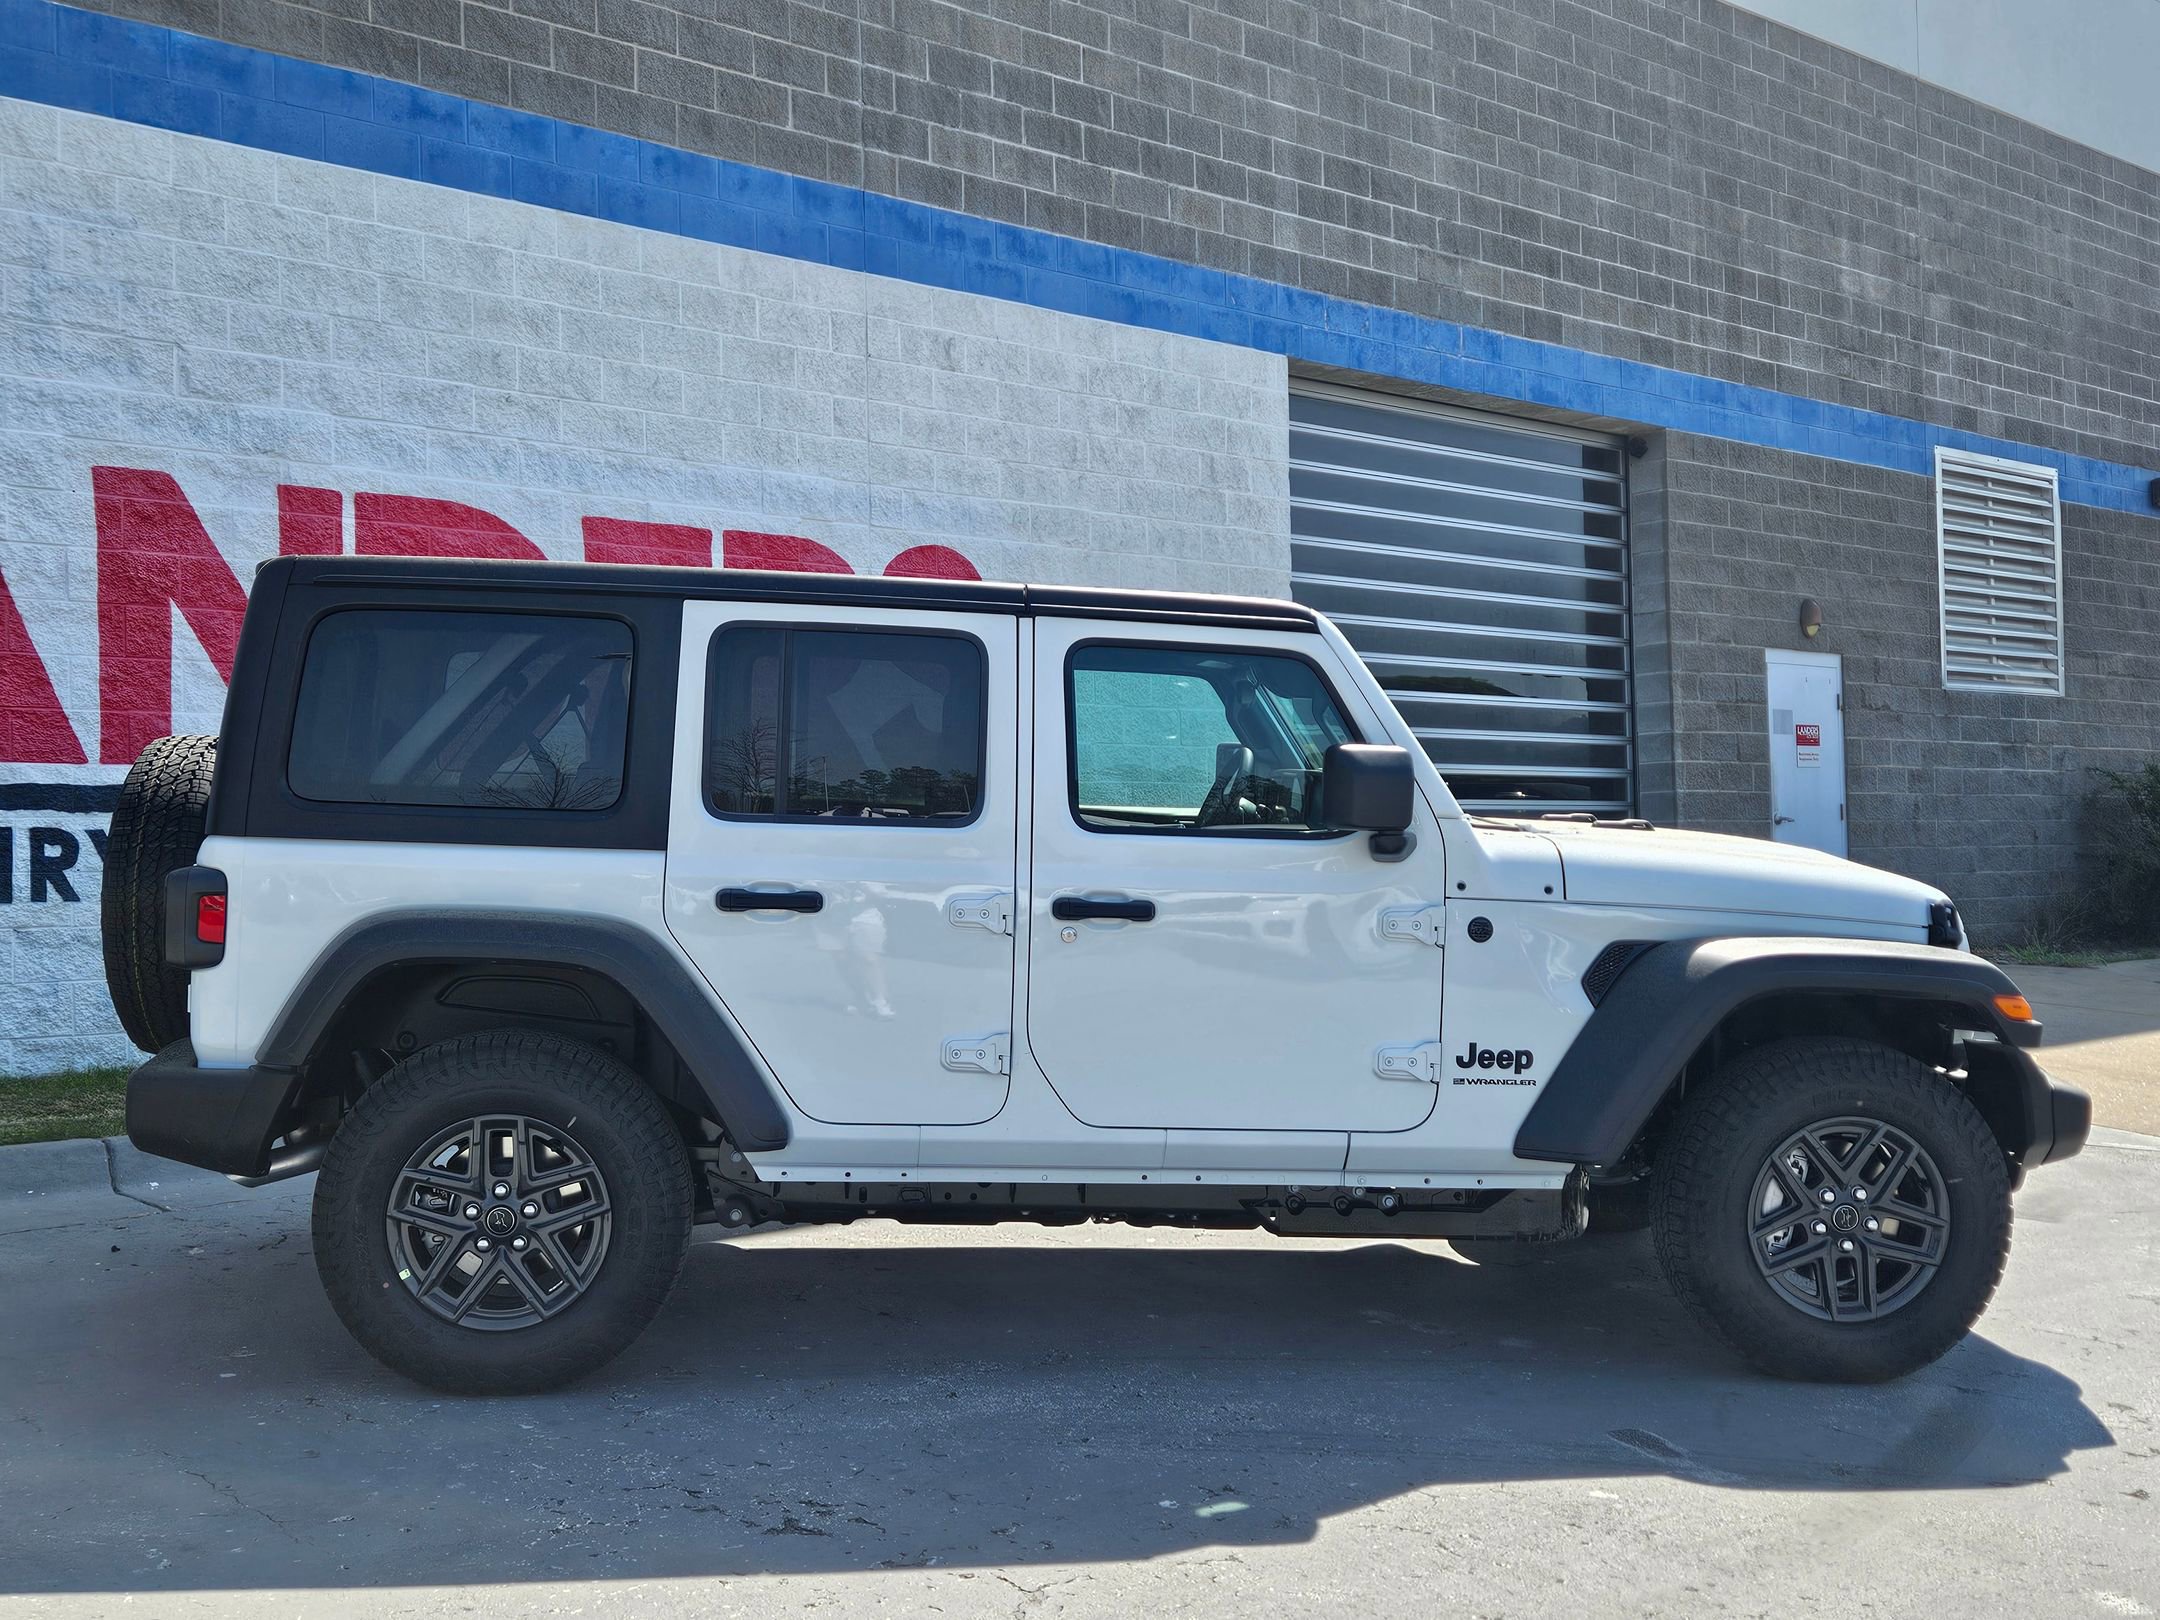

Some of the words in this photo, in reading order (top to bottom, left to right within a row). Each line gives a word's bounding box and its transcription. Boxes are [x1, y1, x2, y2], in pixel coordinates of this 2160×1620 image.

[1797, 726, 1819, 736] LANDERS
[1456, 1042, 1534, 1075] Jeep
[1466, 1078, 1537, 1087] WRANGLER
